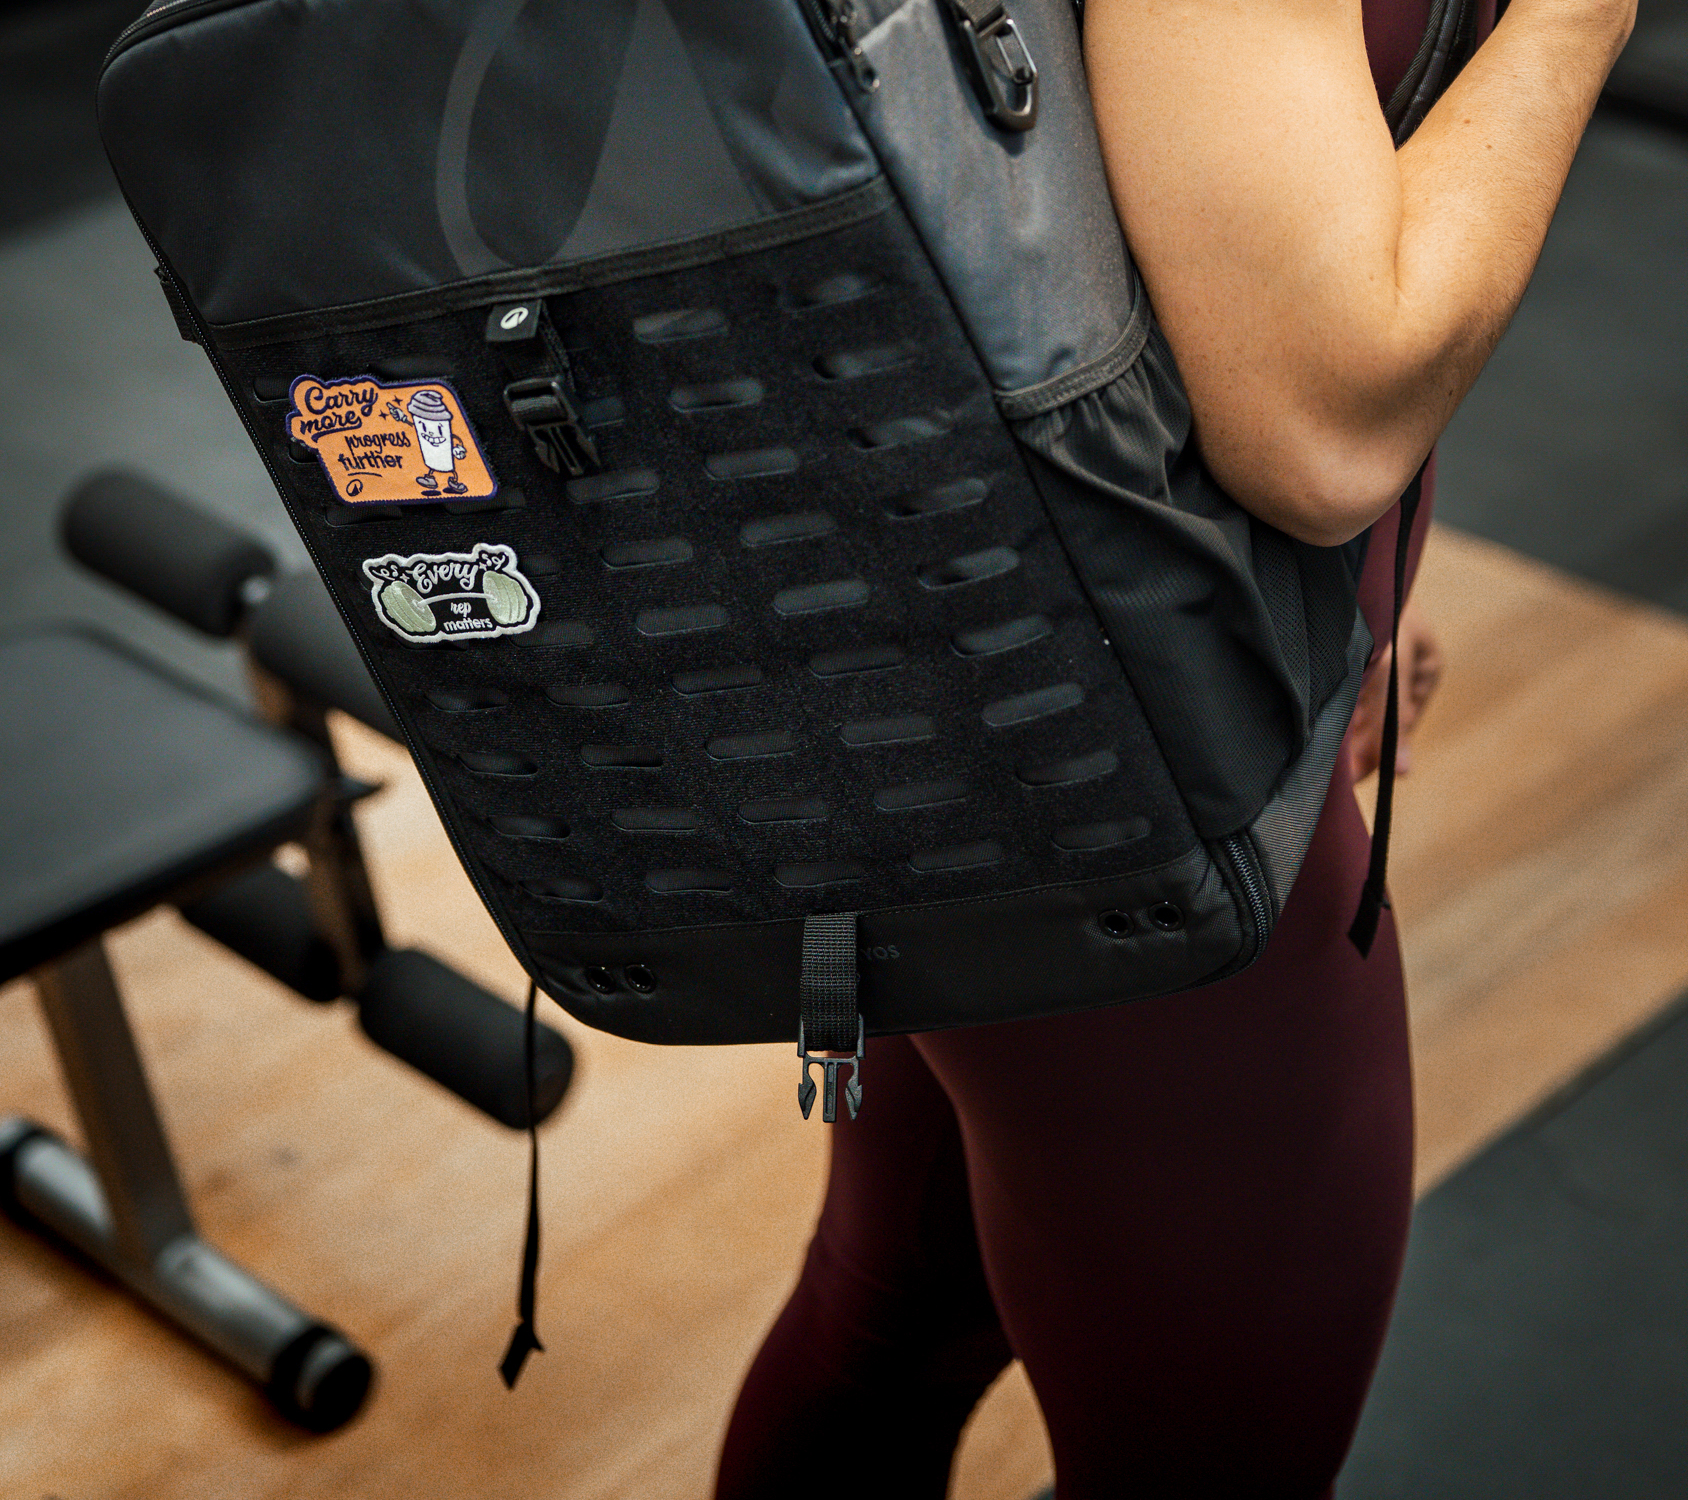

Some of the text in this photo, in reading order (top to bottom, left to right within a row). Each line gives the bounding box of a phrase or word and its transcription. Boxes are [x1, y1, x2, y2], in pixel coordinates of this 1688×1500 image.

[304, 386, 378, 417] Carry
[300, 411, 362, 442] more
[345, 431, 411, 455] progress
[337, 451, 403, 471] further
[406, 562, 479, 594] Every
[450, 601, 472, 619] rep
[443, 616, 493, 632] matters
[861, 944, 900, 960] YOS
